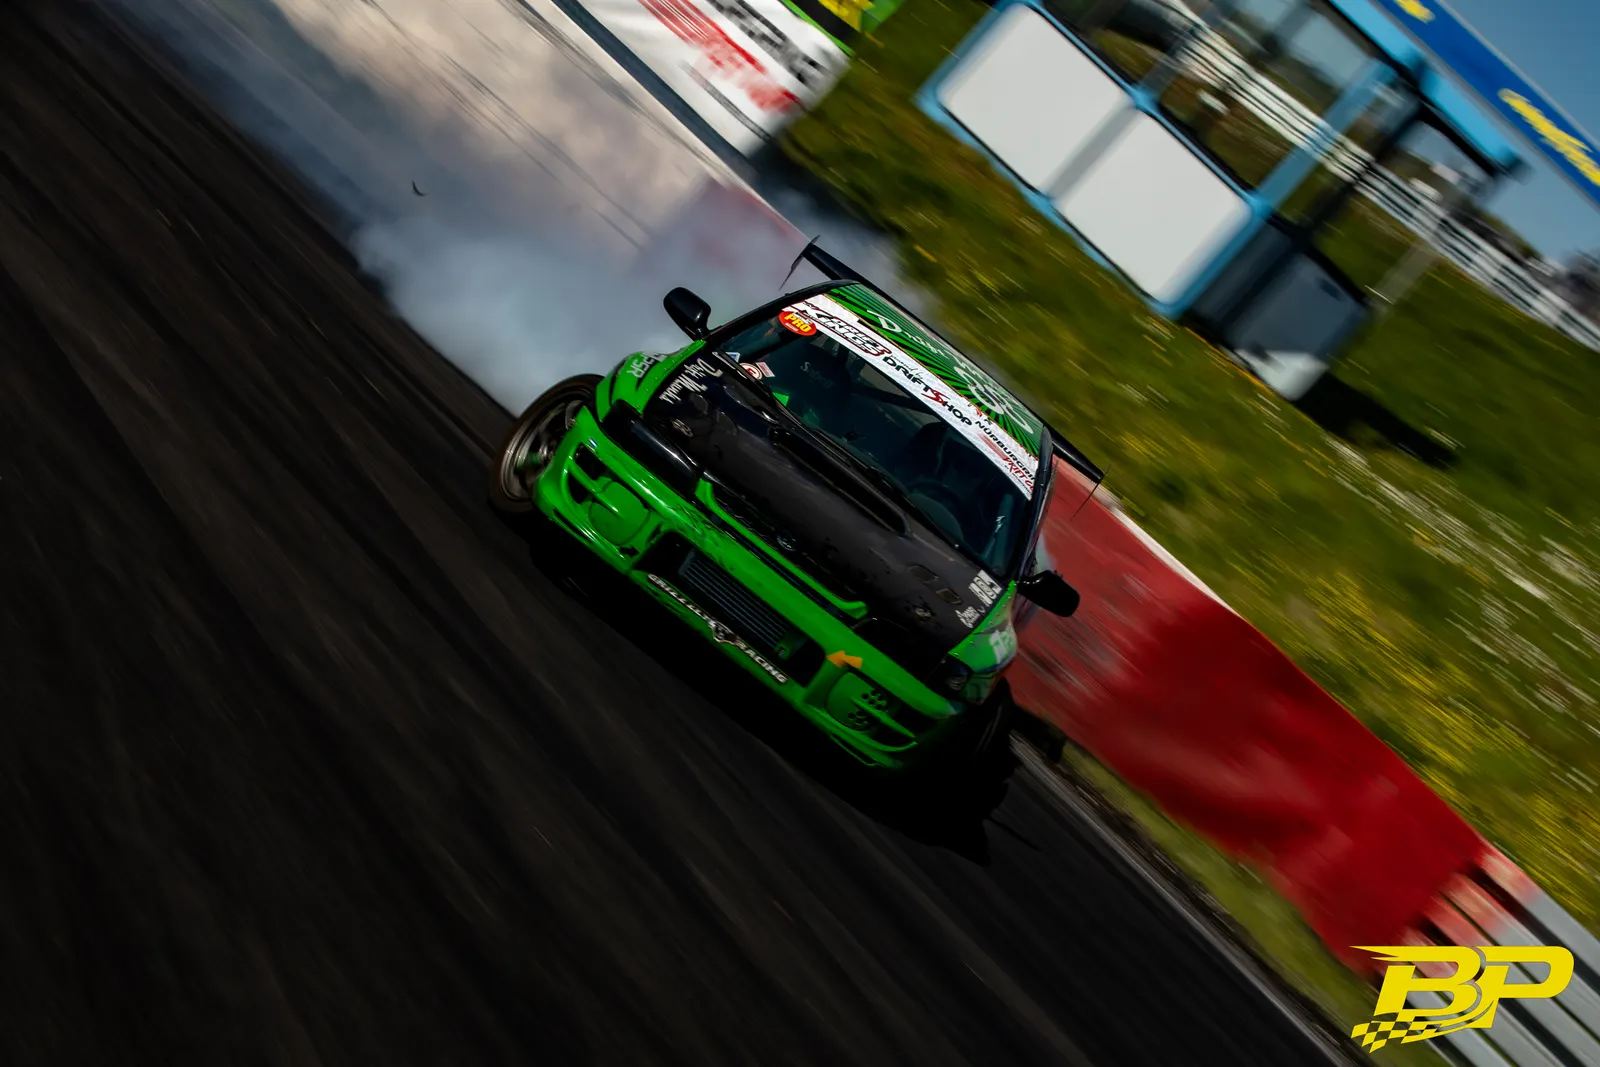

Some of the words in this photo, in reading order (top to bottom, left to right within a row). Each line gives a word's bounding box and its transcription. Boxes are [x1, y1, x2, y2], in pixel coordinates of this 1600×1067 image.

[784, 313, 811, 332] PRO
[802, 305, 882, 355] KINGS
[734, 638, 788, 683] RACING
